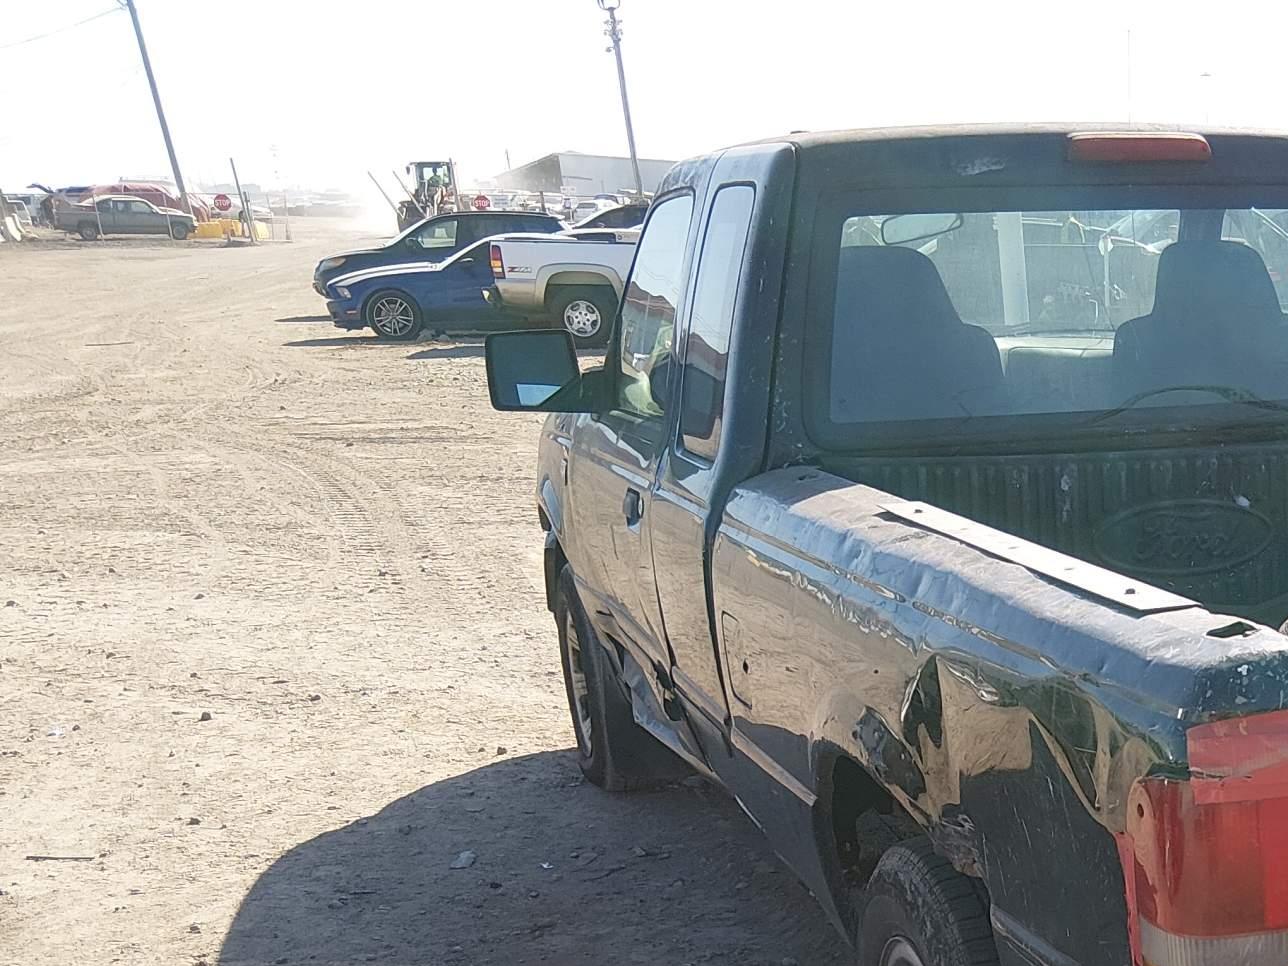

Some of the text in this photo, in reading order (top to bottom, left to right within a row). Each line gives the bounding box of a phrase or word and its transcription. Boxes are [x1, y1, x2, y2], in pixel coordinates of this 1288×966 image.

[214, 199, 231, 208] STOP
[474, 199, 490, 208] STOP
[1133, 509, 1243, 561] Ford
